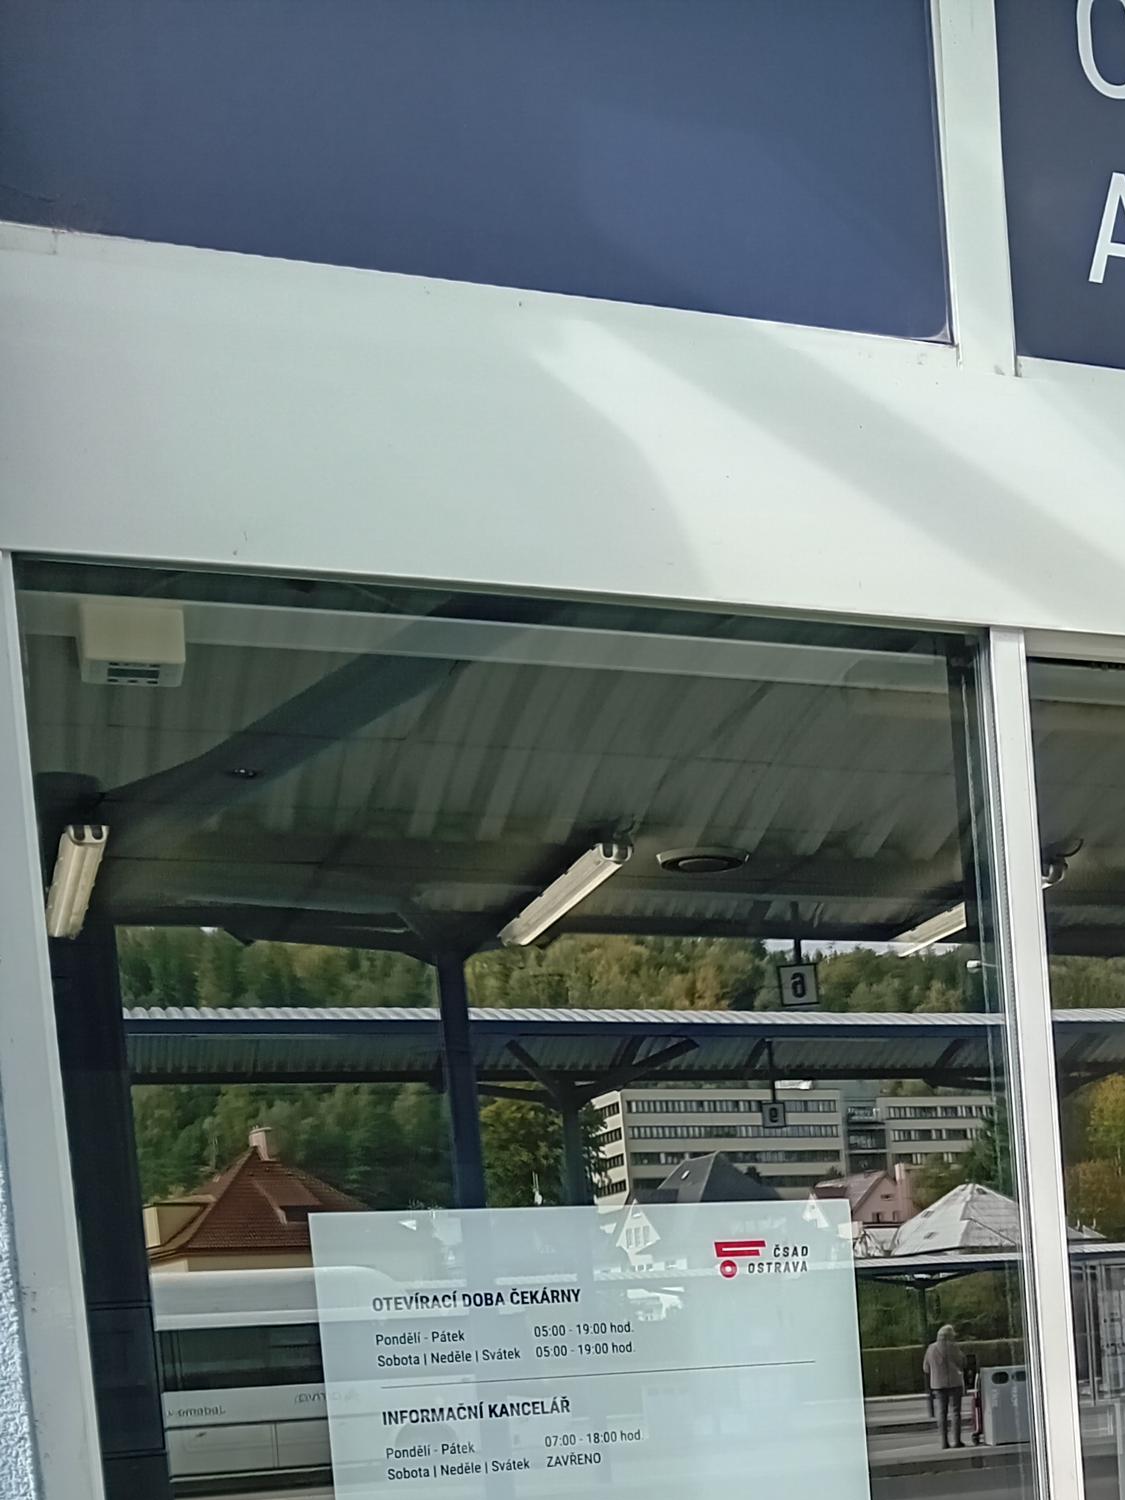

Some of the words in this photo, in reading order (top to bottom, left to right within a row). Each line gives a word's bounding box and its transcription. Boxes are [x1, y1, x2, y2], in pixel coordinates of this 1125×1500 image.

[773, 1244, 809, 1258] ČSAD
[748, 1260, 808, 1274] OSTRAVA
[372, 1291, 458, 1312] OTEVÍRACÍ
[462, 1292, 504, 1308] DOBA
[510, 1287, 582, 1306] ČEKÁRNY
[375, 1331, 421, 1346] Pondělí
[431, 1329, 465, 1343] Pátek
[534, 1325, 566, 1338] 05:00
[576, 1322, 607, 1335] 19:00
[610, 1321, 635, 1334] hod.
[377, 1354, 420, 1368] Sobota
[431, 1349, 472, 1364] Neděle
[482, 1348, 521, 1361] Svátek
[535, 1345, 568, 1359] 05:00
[578, 1342, 608, 1355] 19:00
[382, 1401, 484, 1426] INFORMAČNÍ
[488, 1396, 570, 1418] KANCELÁŘ
[386, 1445, 430, 1460] Pondělí
[441, 1442, 475, 1456] Pátek
[545, 1434, 577, 1447] 07:00
[586, 1431, 617, 1444] 18:00
[387, 1467, 430, 1481] Sobota
[440, 1462, 481, 1476] Neděle
[491, 1458, 530, 1472] Svátek
[546, 1452, 601, 1468] ZAVŘENO
